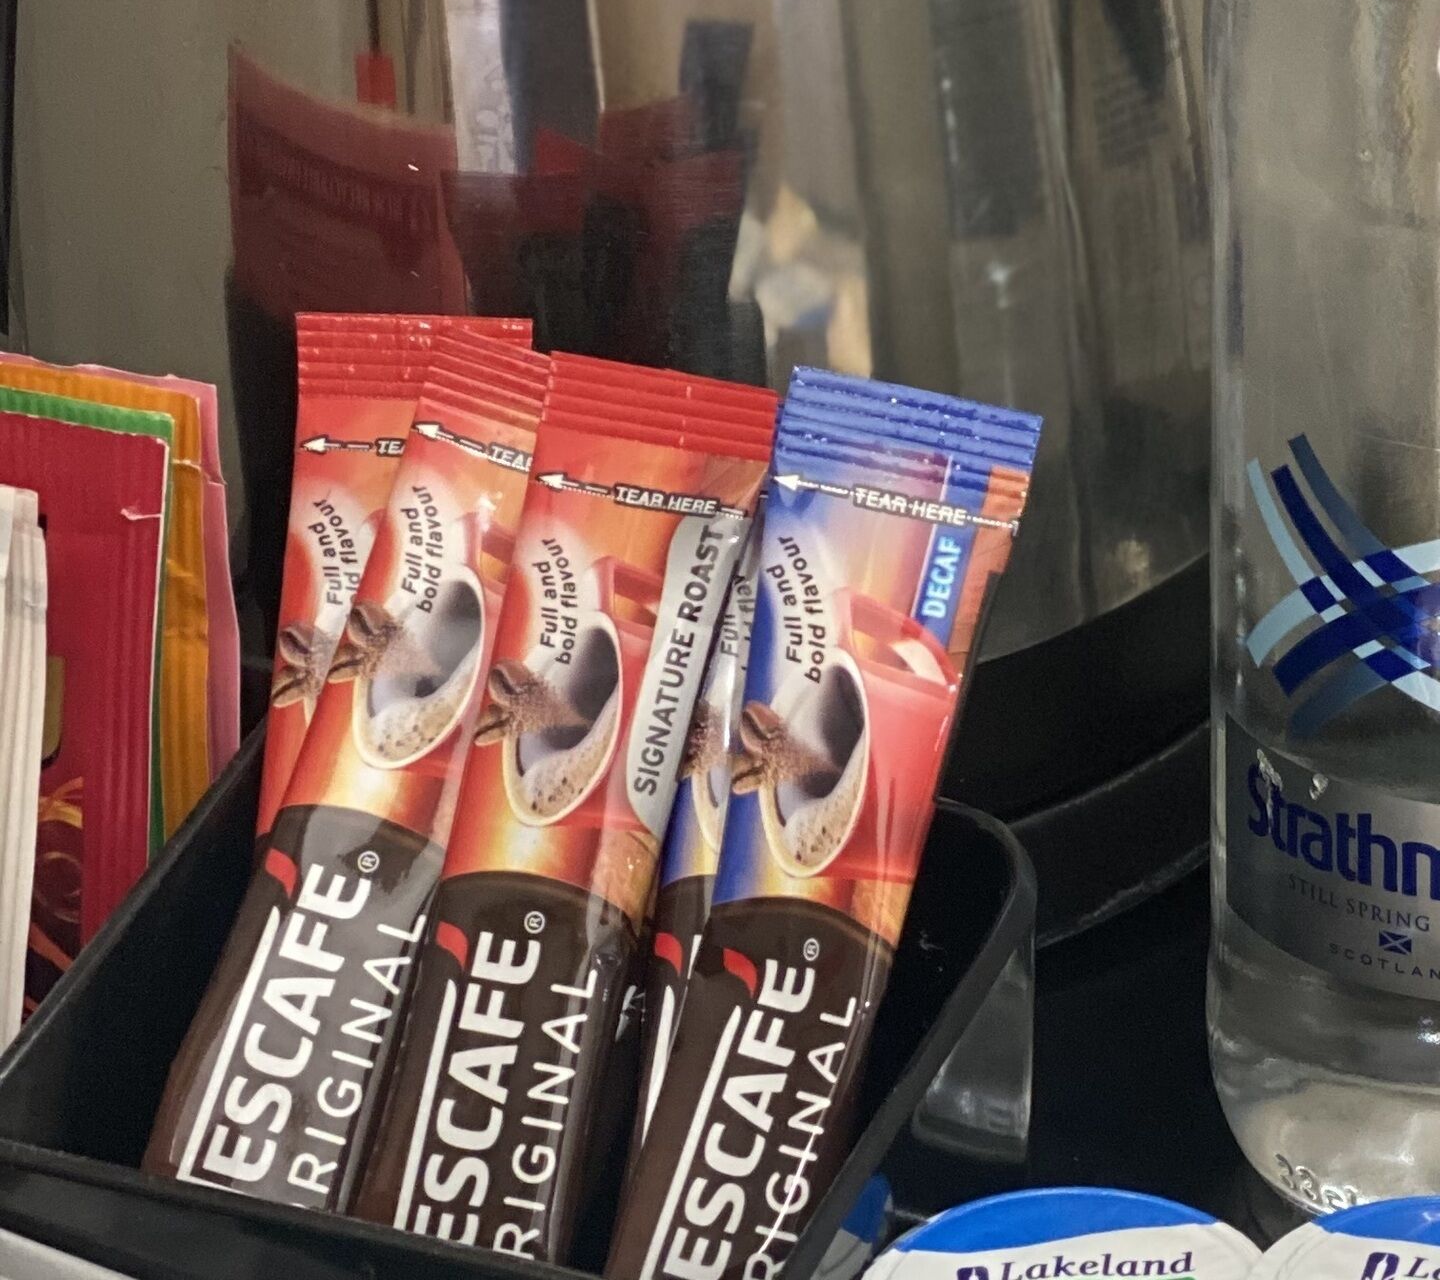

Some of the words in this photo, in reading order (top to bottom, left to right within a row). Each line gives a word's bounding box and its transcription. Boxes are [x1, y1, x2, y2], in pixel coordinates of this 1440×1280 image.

[411, 486, 444, 559] flavour
[616, 485, 663, 509] TEAR
[668, 497, 717, 515] HERE
[854, 487, 907, 513] TEAR
[912, 501, 967, 525] HERE
[308, 522, 337, 558] and
[313, 499, 359, 564] flavour
[401, 507, 423, 546] and
[326, 565, 342, 606] Full
[402, 553, 423, 594] Full
[416, 568, 443, 614] bold
[532, 561, 557, 600] and
[542, 538, 579, 612] flavour
[766, 563, 798, 607] and
[776, 535, 825, 615] flavour
[921, 535, 963, 618] DECAF
[539, 606, 557, 648] Full
[555, 618, 579, 665] bold
[786, 617, 802, 663] Full
[634, 628, 695, 796] SIGNATURE
[680, 524, 725, 623] ROAST
[805, 622, 827, 684] bold
[1287, 873, 1339, 910] STILL
[1346, 898, 1432, 933] SPRING
[287, 914, 428, 1196] RIGINAL
[492, 968, 599, 1261] RIGINAL
